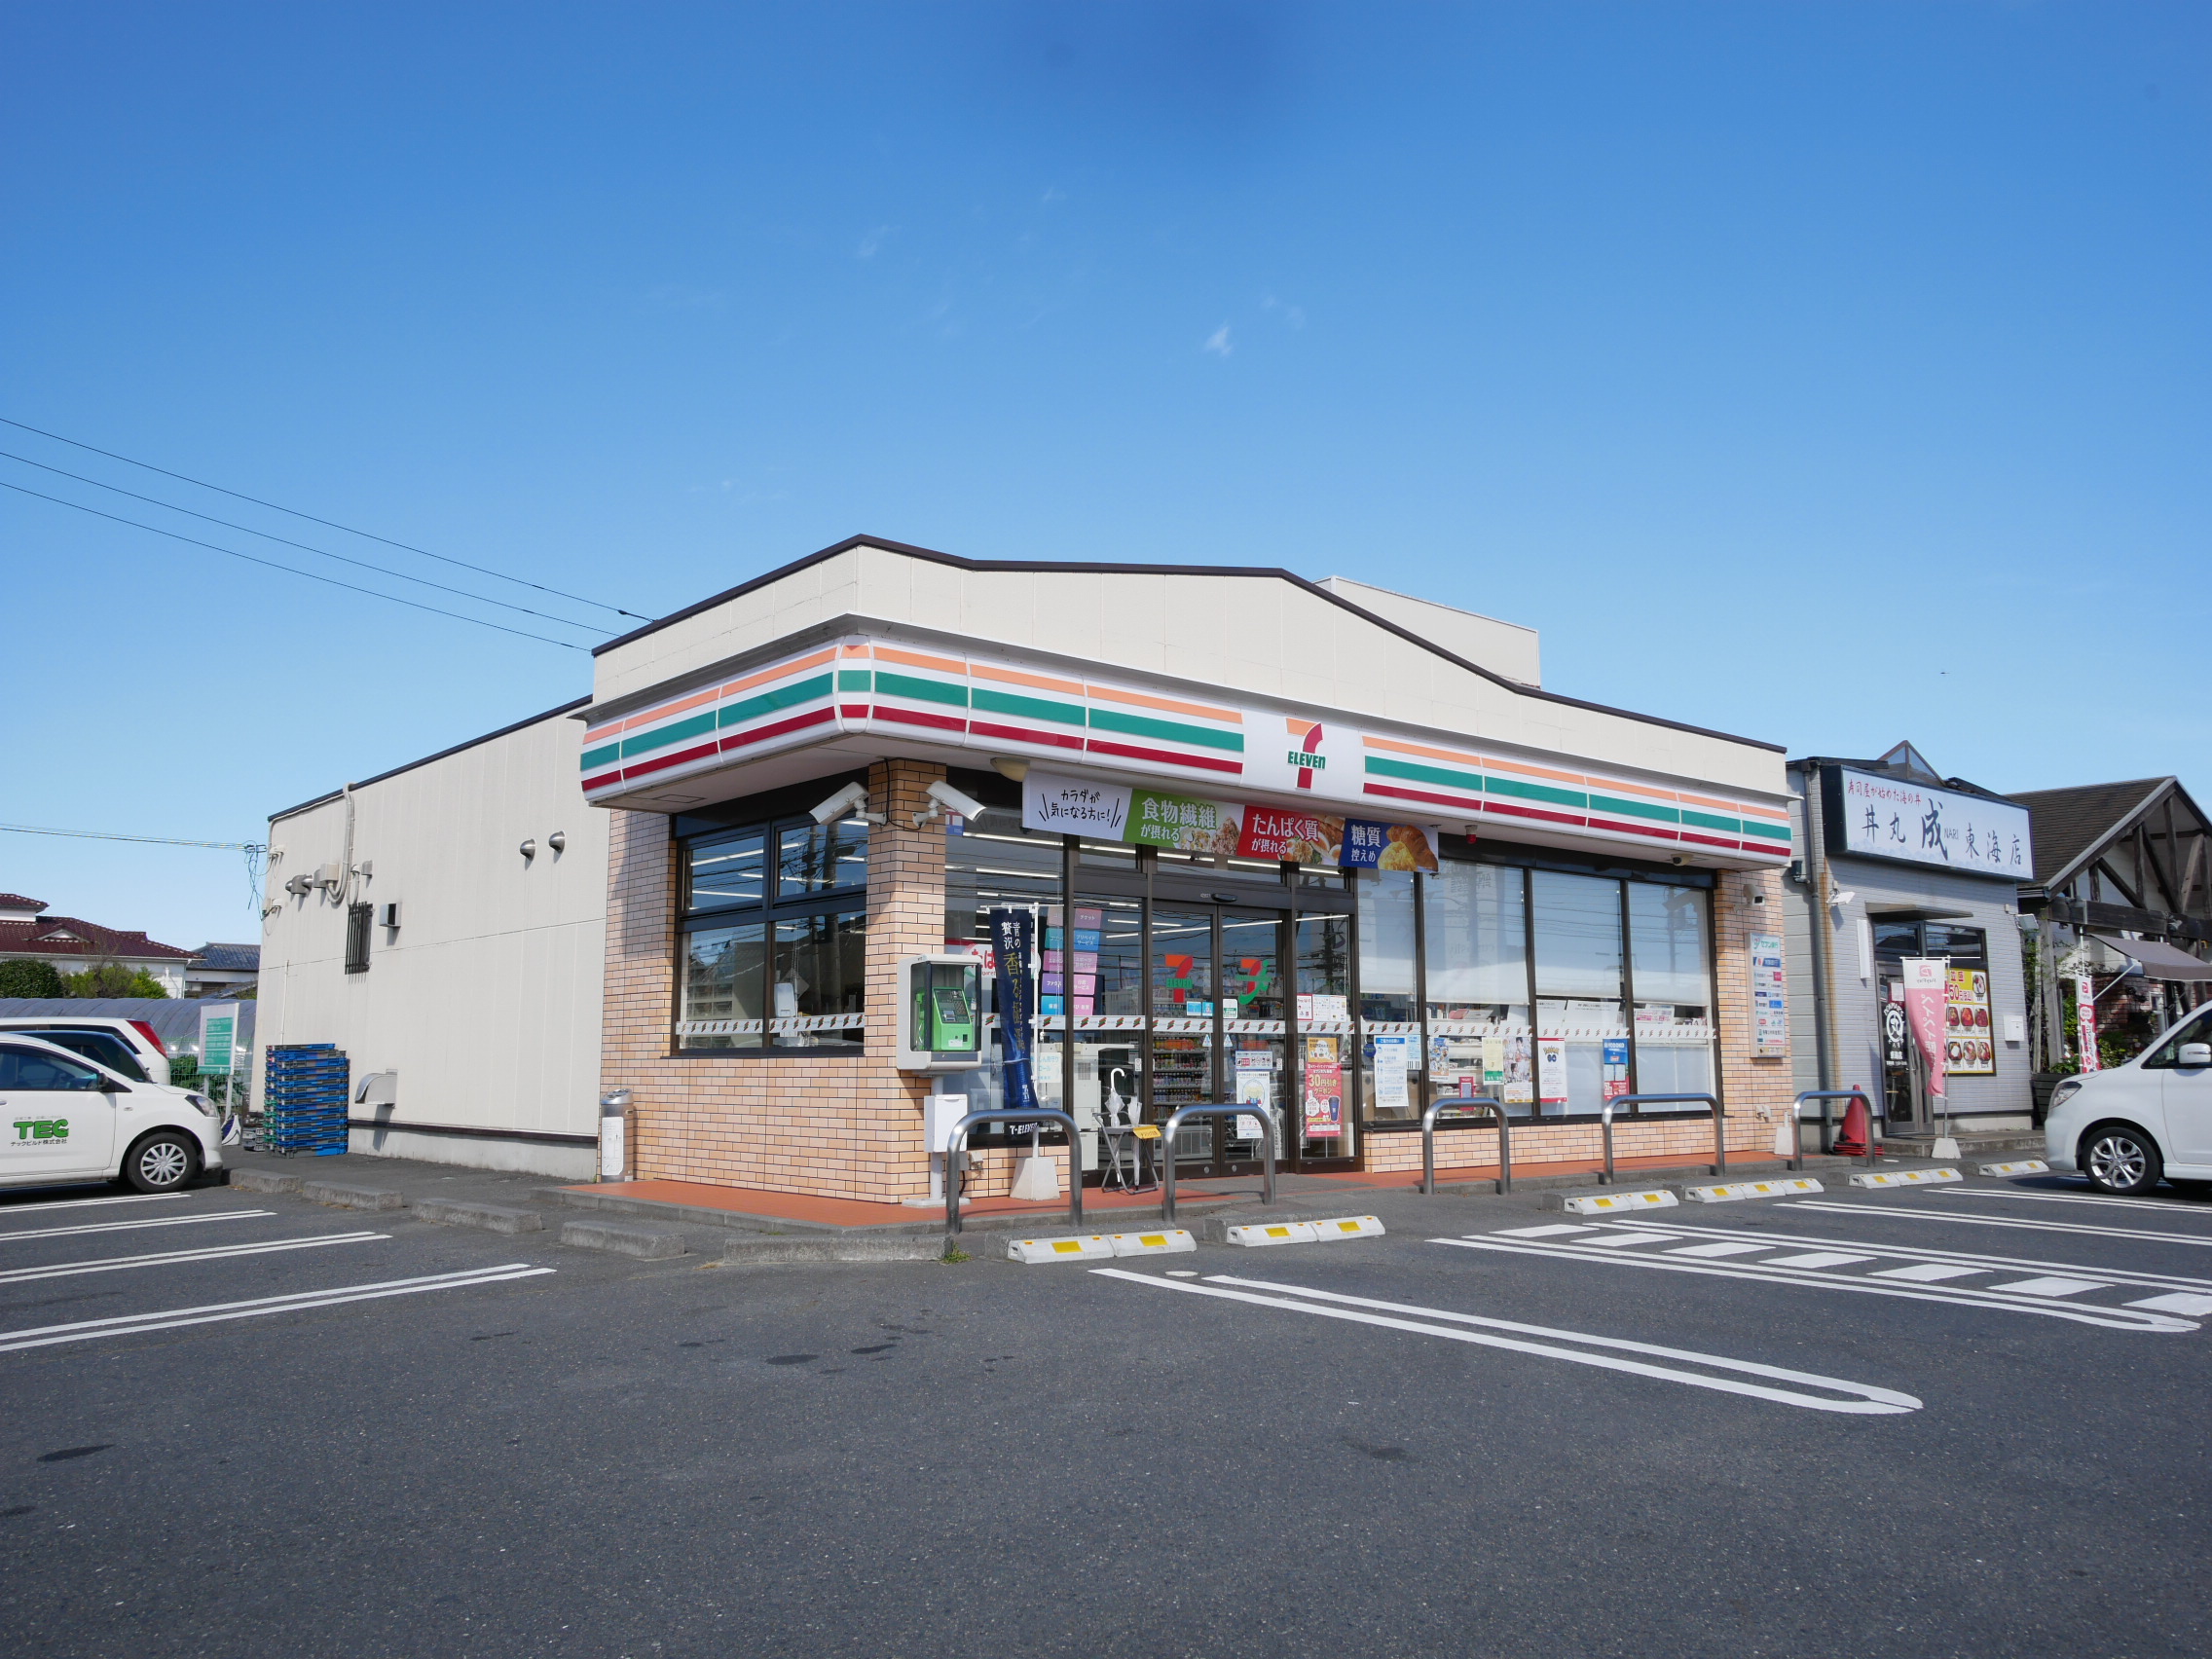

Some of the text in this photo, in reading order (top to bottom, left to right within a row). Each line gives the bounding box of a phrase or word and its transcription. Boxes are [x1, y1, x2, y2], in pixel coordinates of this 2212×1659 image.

[1060, 788, 1101, 804] カラダが
[1141, 796, 1217, 830] 食物繊維
[1140, 824, 1181, 843] が摂れる
[1251, 813, 1319, 842] たんぱく質
[1350, 824, 1382, 849] 糖質
[1921, 797, 1948, 862] 成
[1944, 827, 1960, 841] NARI
[1965, 822, 2022, 866] 東海店
[1250, 838, 1288, 855] が摂れる
[1350, 849, 1377, 864] 控えめ
[1001, 921, 1014, 950] 贅沢
[1012, 921, 1021, 948] 青の
[1308, 1073, 1338, 1088] 30円引き
